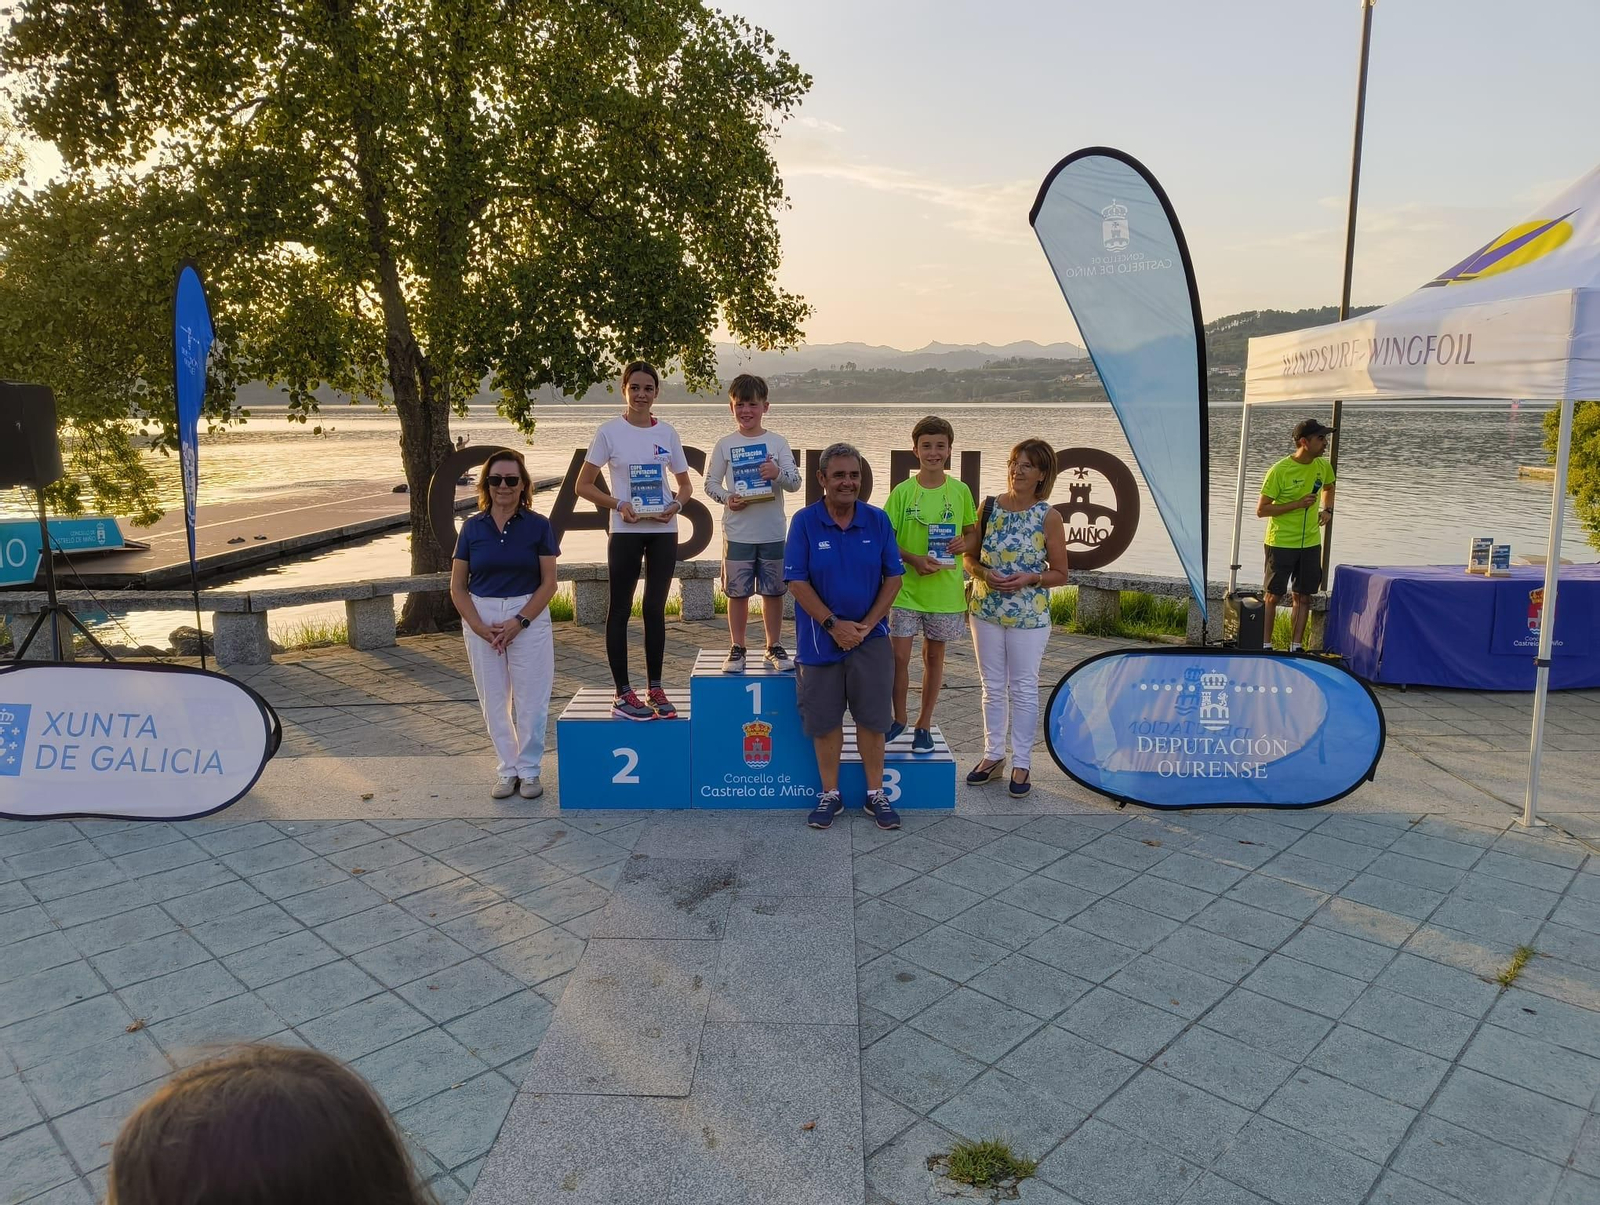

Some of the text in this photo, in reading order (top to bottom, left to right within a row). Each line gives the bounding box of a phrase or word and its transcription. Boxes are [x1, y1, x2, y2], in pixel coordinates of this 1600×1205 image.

[1068, 526, 1109, 543] MIÑO
[745, 682, 762, 715] 1
[41, 711, 158, 739] XUNTA
[1137, 734, 1288, 756] DEPUTACIÓN
[35, 744, 225, 775] DE GALICIA
[612, 747, 640, 784] 2
[1157, 760, 1268, 779] OURENSE
[723, 773, 791, 784] Concello de
[700, 785, 815, 797] Castrelo de Miño
